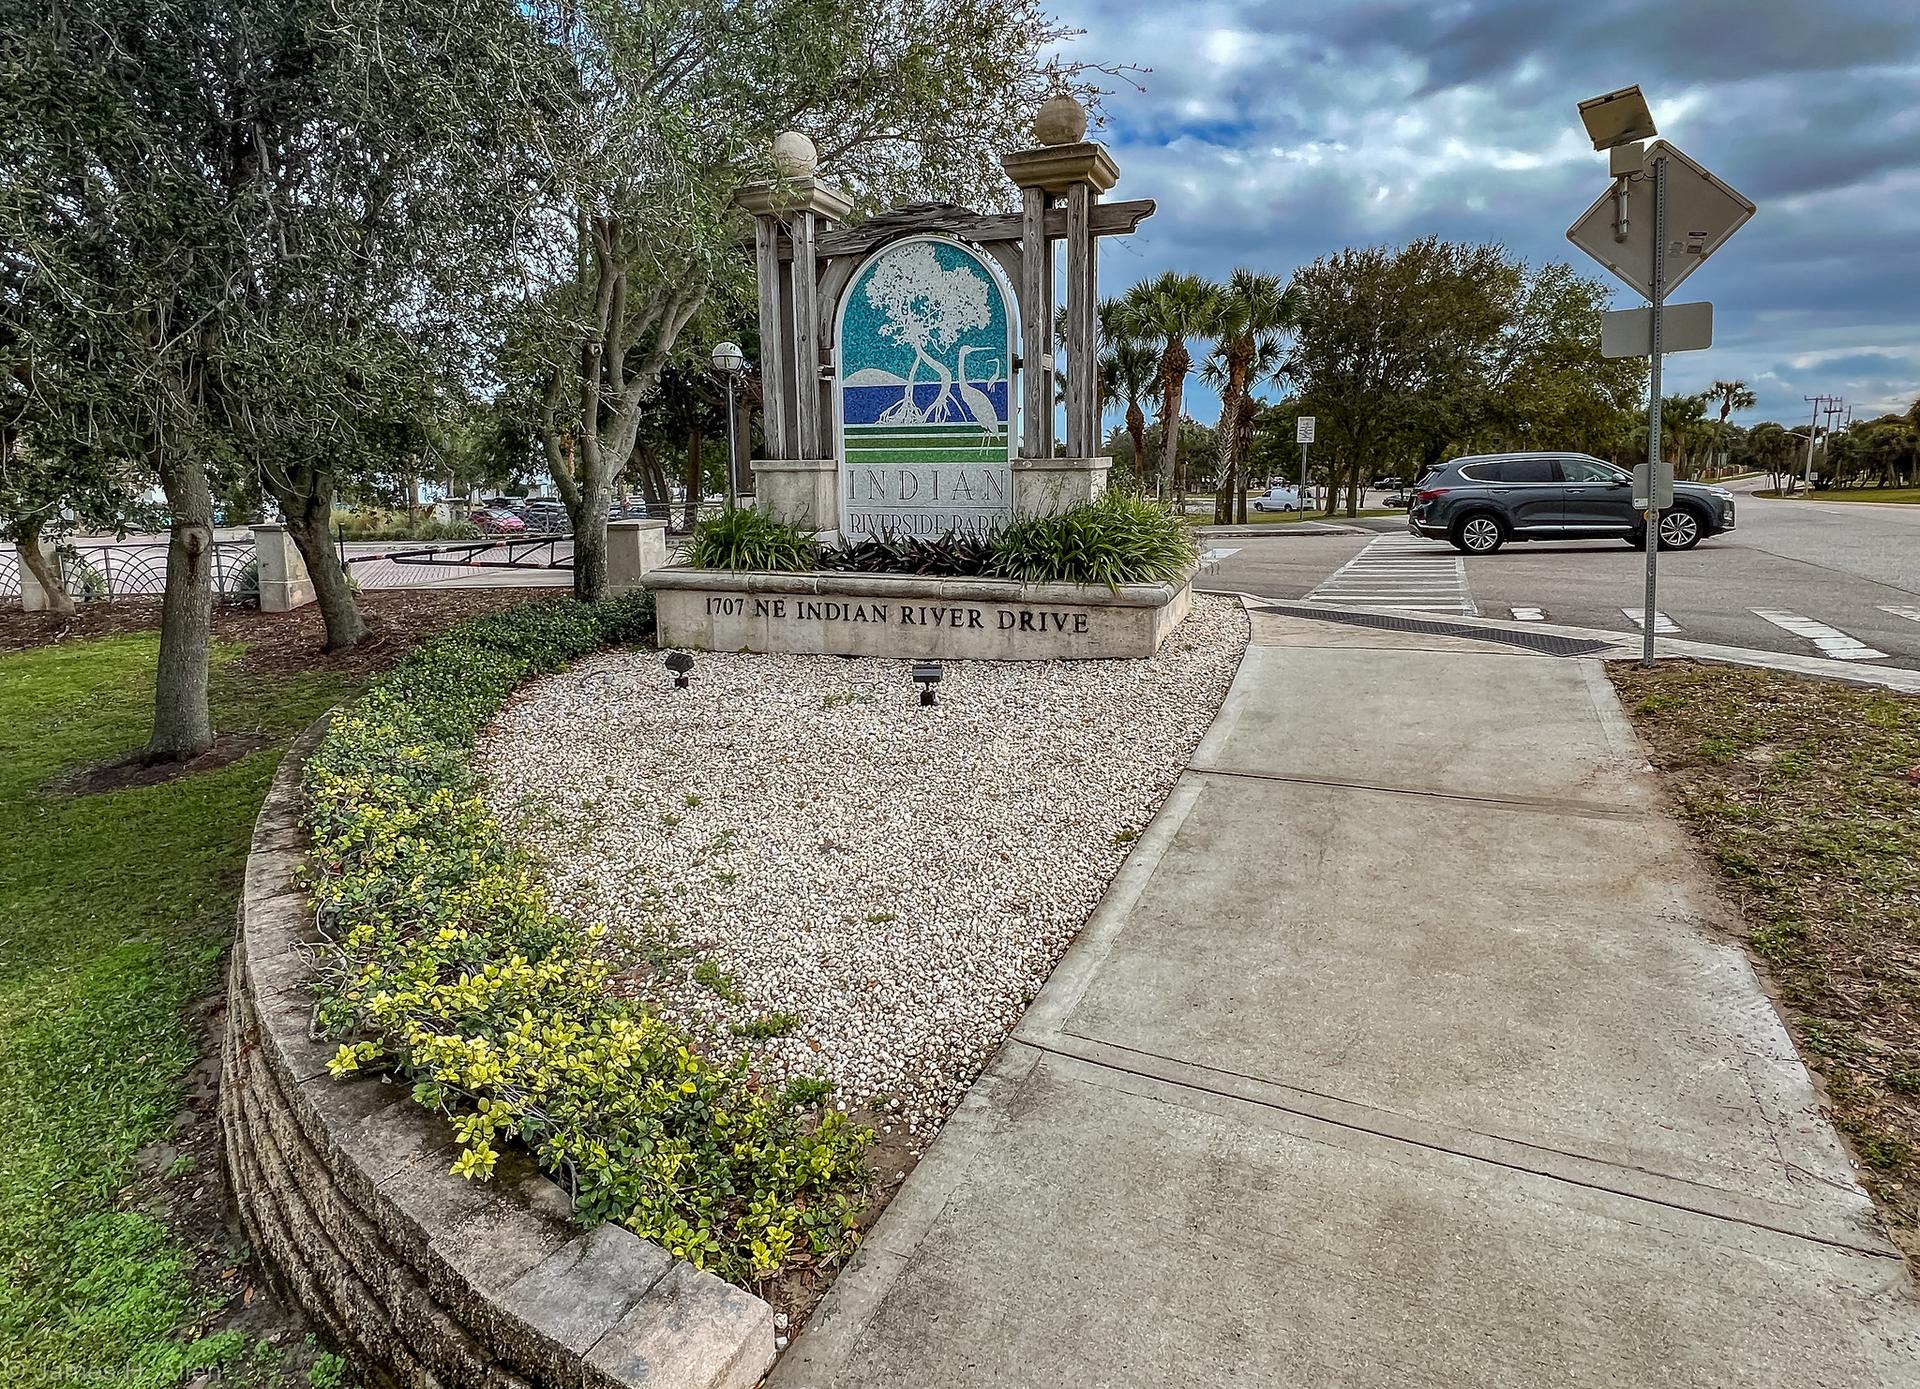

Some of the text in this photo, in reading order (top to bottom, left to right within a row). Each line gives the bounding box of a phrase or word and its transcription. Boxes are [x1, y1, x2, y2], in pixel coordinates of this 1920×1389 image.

[848, 470, 1005, 501] INDIAN
[850, 513, 1003, 538] RIVERSIDE PARK
[705, 597, 1089, 634] 1707 NE INDIAN RIVER DRIVE
